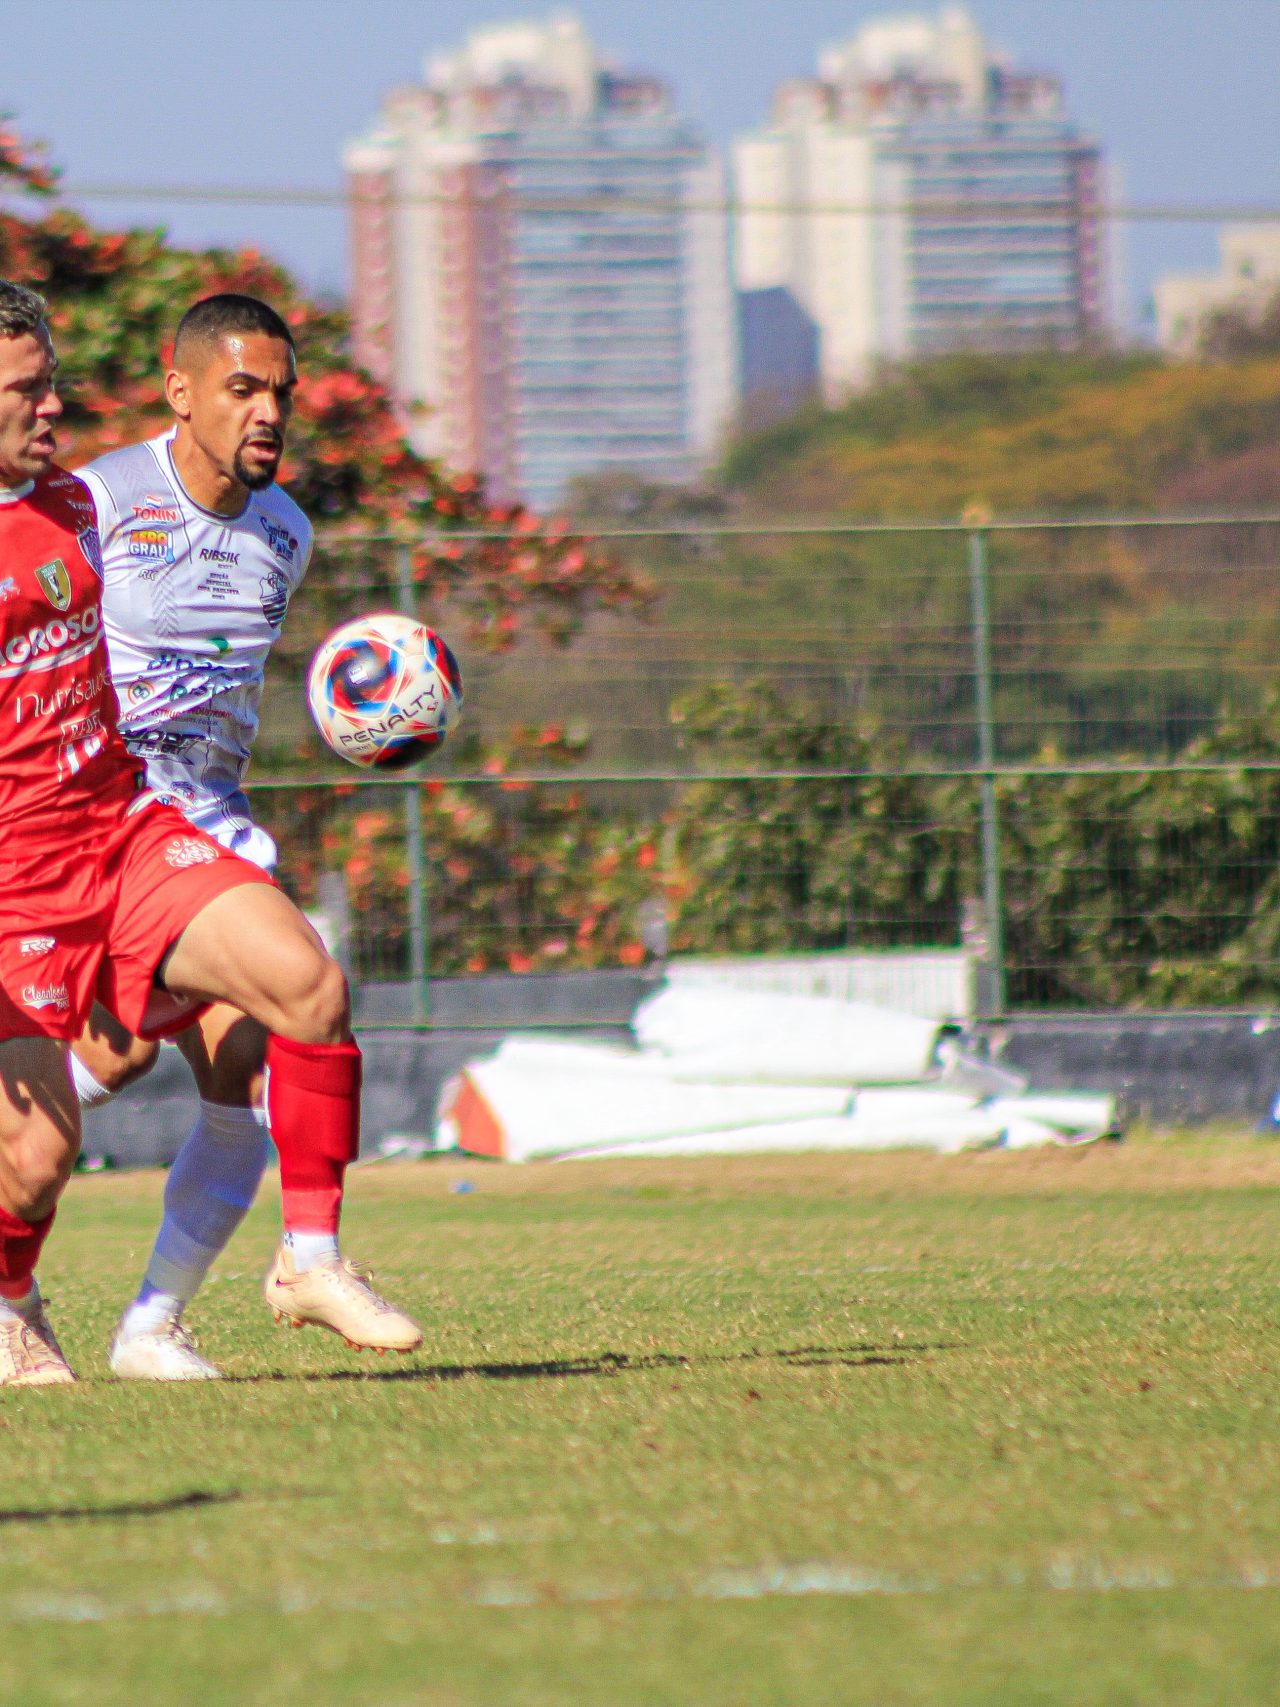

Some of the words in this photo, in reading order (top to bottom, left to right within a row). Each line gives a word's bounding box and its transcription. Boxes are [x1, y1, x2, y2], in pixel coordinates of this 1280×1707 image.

[132, 507, 177, 521] TONIN
[129, 543, 168, 559] GRAU
[339, 684, 437, 747] PENALTY
